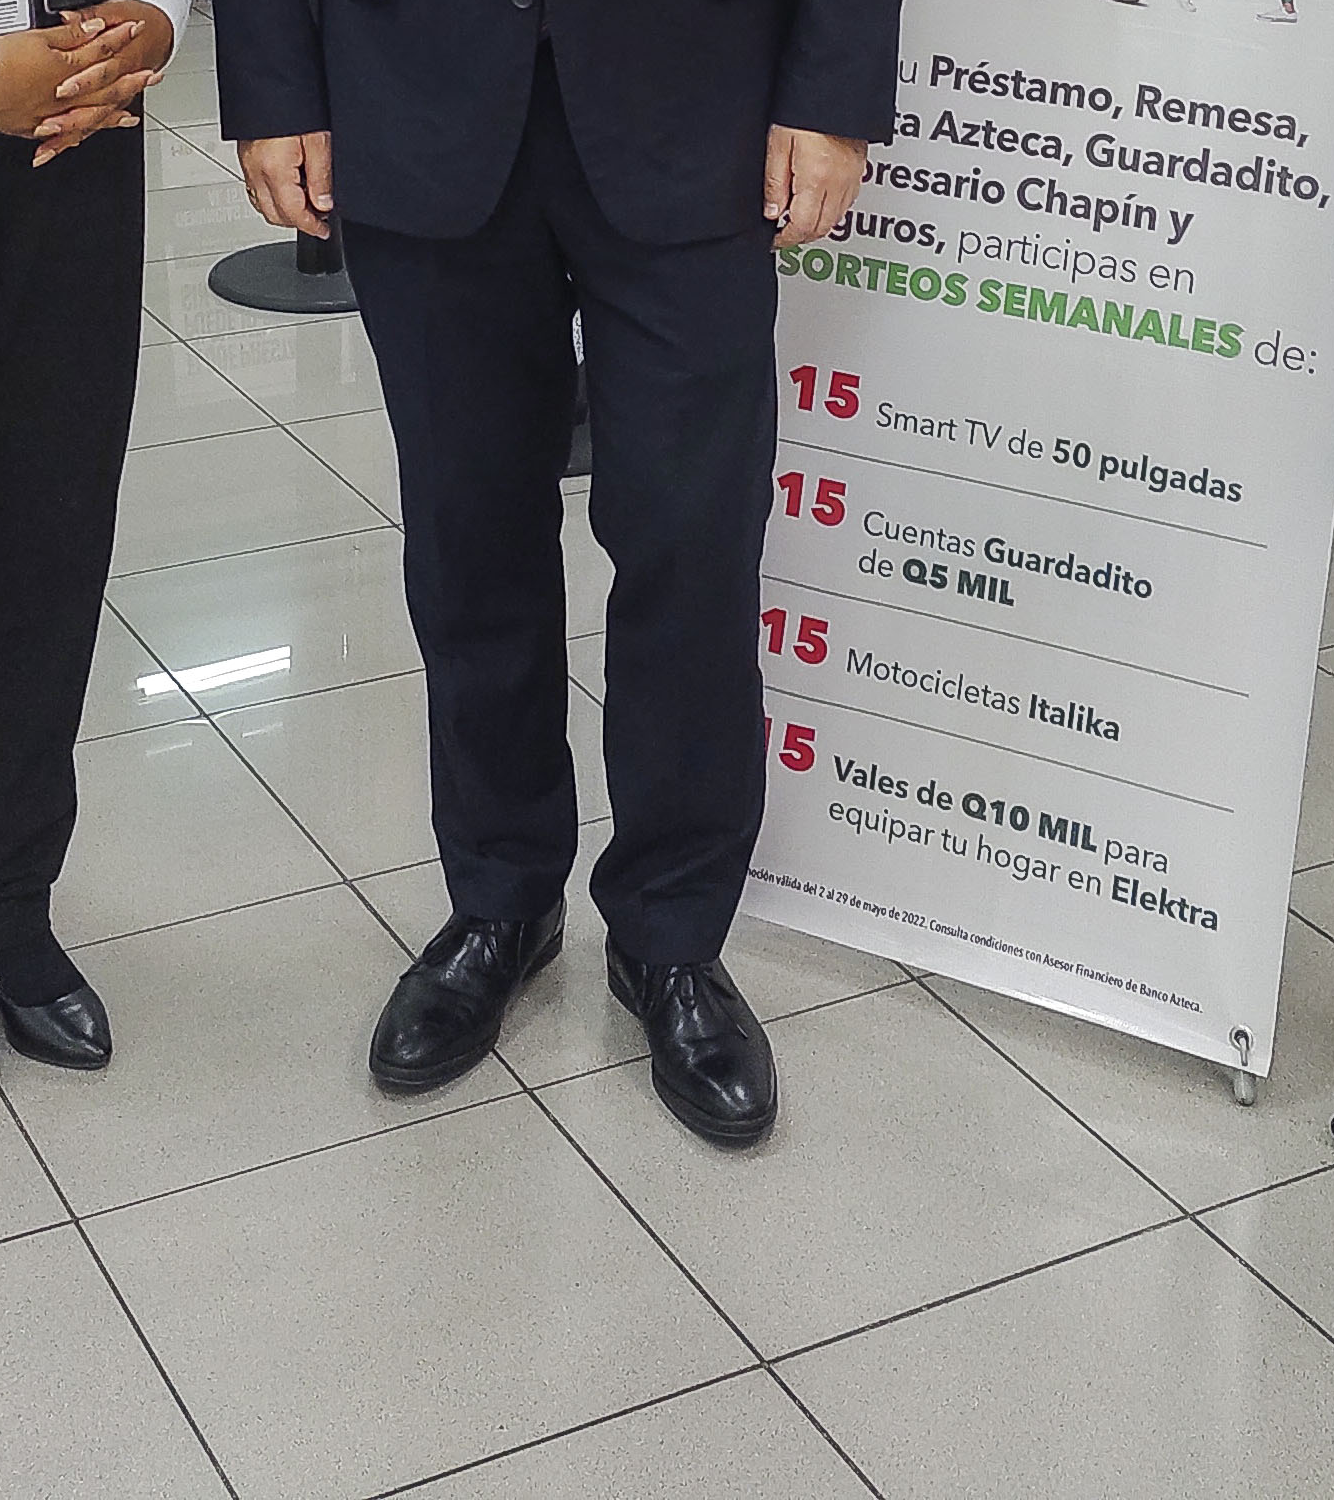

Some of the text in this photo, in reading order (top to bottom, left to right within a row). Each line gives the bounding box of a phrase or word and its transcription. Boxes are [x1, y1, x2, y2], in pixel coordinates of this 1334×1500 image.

[929, 54, 1310, 149] Préstamo, Remesa,
[929, 110, 1331, 209] Azteca, Guardadito,
[957, 230, 1195, 295] participas en
[1017, 177, 1195, 245] Chapín y
[777, 245, 1318, 375] SORTEOS SEMANALES de:
[789, 365, 1244, 504] 15 Smart TV de 50 pulgadas
[776, 471, 1154, 601] 15 Cuentas Guardadito
[857, 548, 1016, 607] de Q5 MIL
[760, 608, 1121, 743] 15 Motocicletas Italika
[828, 802, 1219, 931] equipar tu hogar en Elektra
[833, 753, 1169, 874] Vales de Q10 MIL para
[803, 881, 818, 896] del
[818, 886, 825, 899] 2
[826, 889, 835, 901] al
[835, 891, 849, 906] 29
[849, 895, 862, 909] de
[862, 901, 887, 919] mayo
[888, 906, 901, 921] de
[929, 918, 969, 941] Consulta
[969, 929, 1024, 958] condiciones
[1025, 950, 1042, 964] con
[1043, 953, 1074, 973] Asesor
[1075, 963, 1123, 988] Financiero
[1125, 978, 1138, 993] de
[1139, 983, 1169, 1003] Banco
